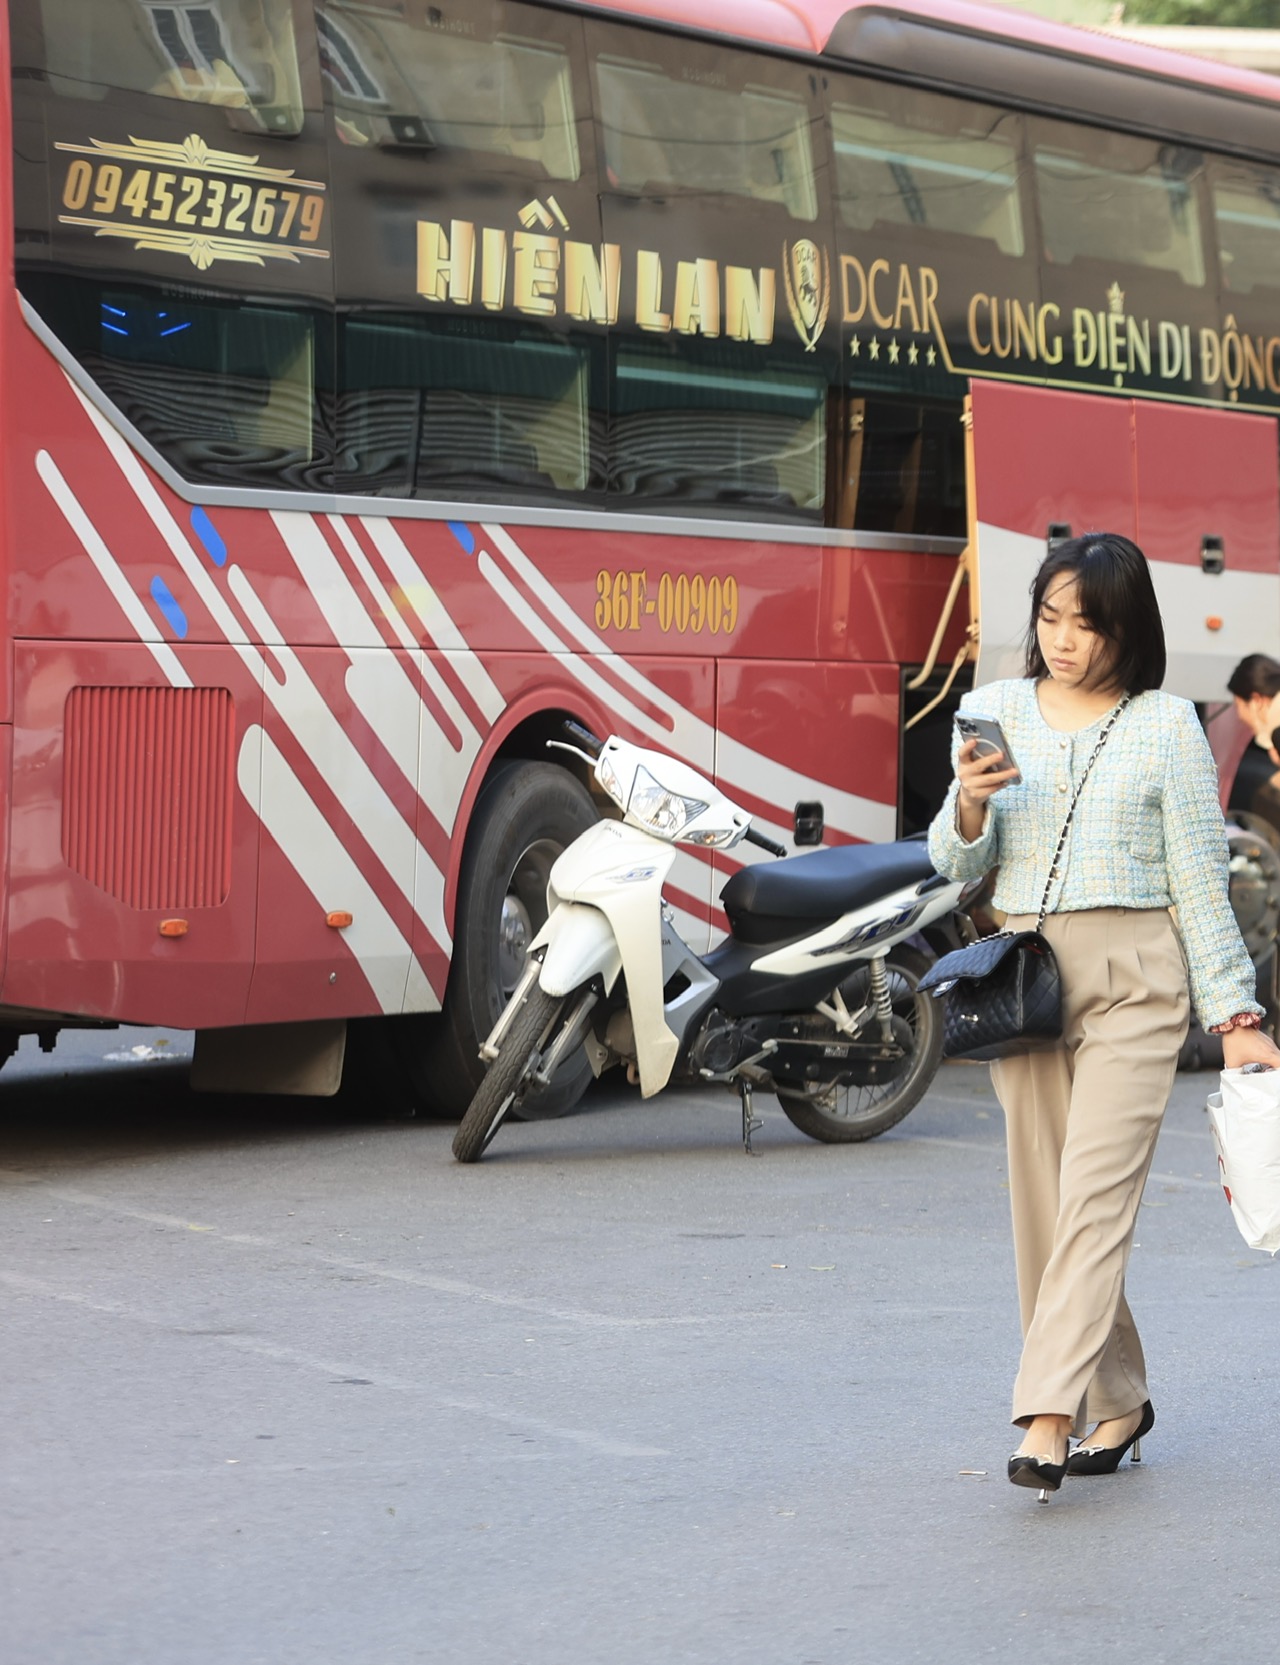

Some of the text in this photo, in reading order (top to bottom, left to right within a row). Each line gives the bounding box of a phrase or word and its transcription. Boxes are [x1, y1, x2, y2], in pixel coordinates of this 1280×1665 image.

[63, 159, 324, 242] 0945232679
[416, 195, 775, 345] HIỀN LAN
[840, 254, 940, 333] DCAR
[968, 292, 1063, 365] CUNG
[1159, 320, 1192, 381] DI
[595, 568, 738, 635] 36F-00909
